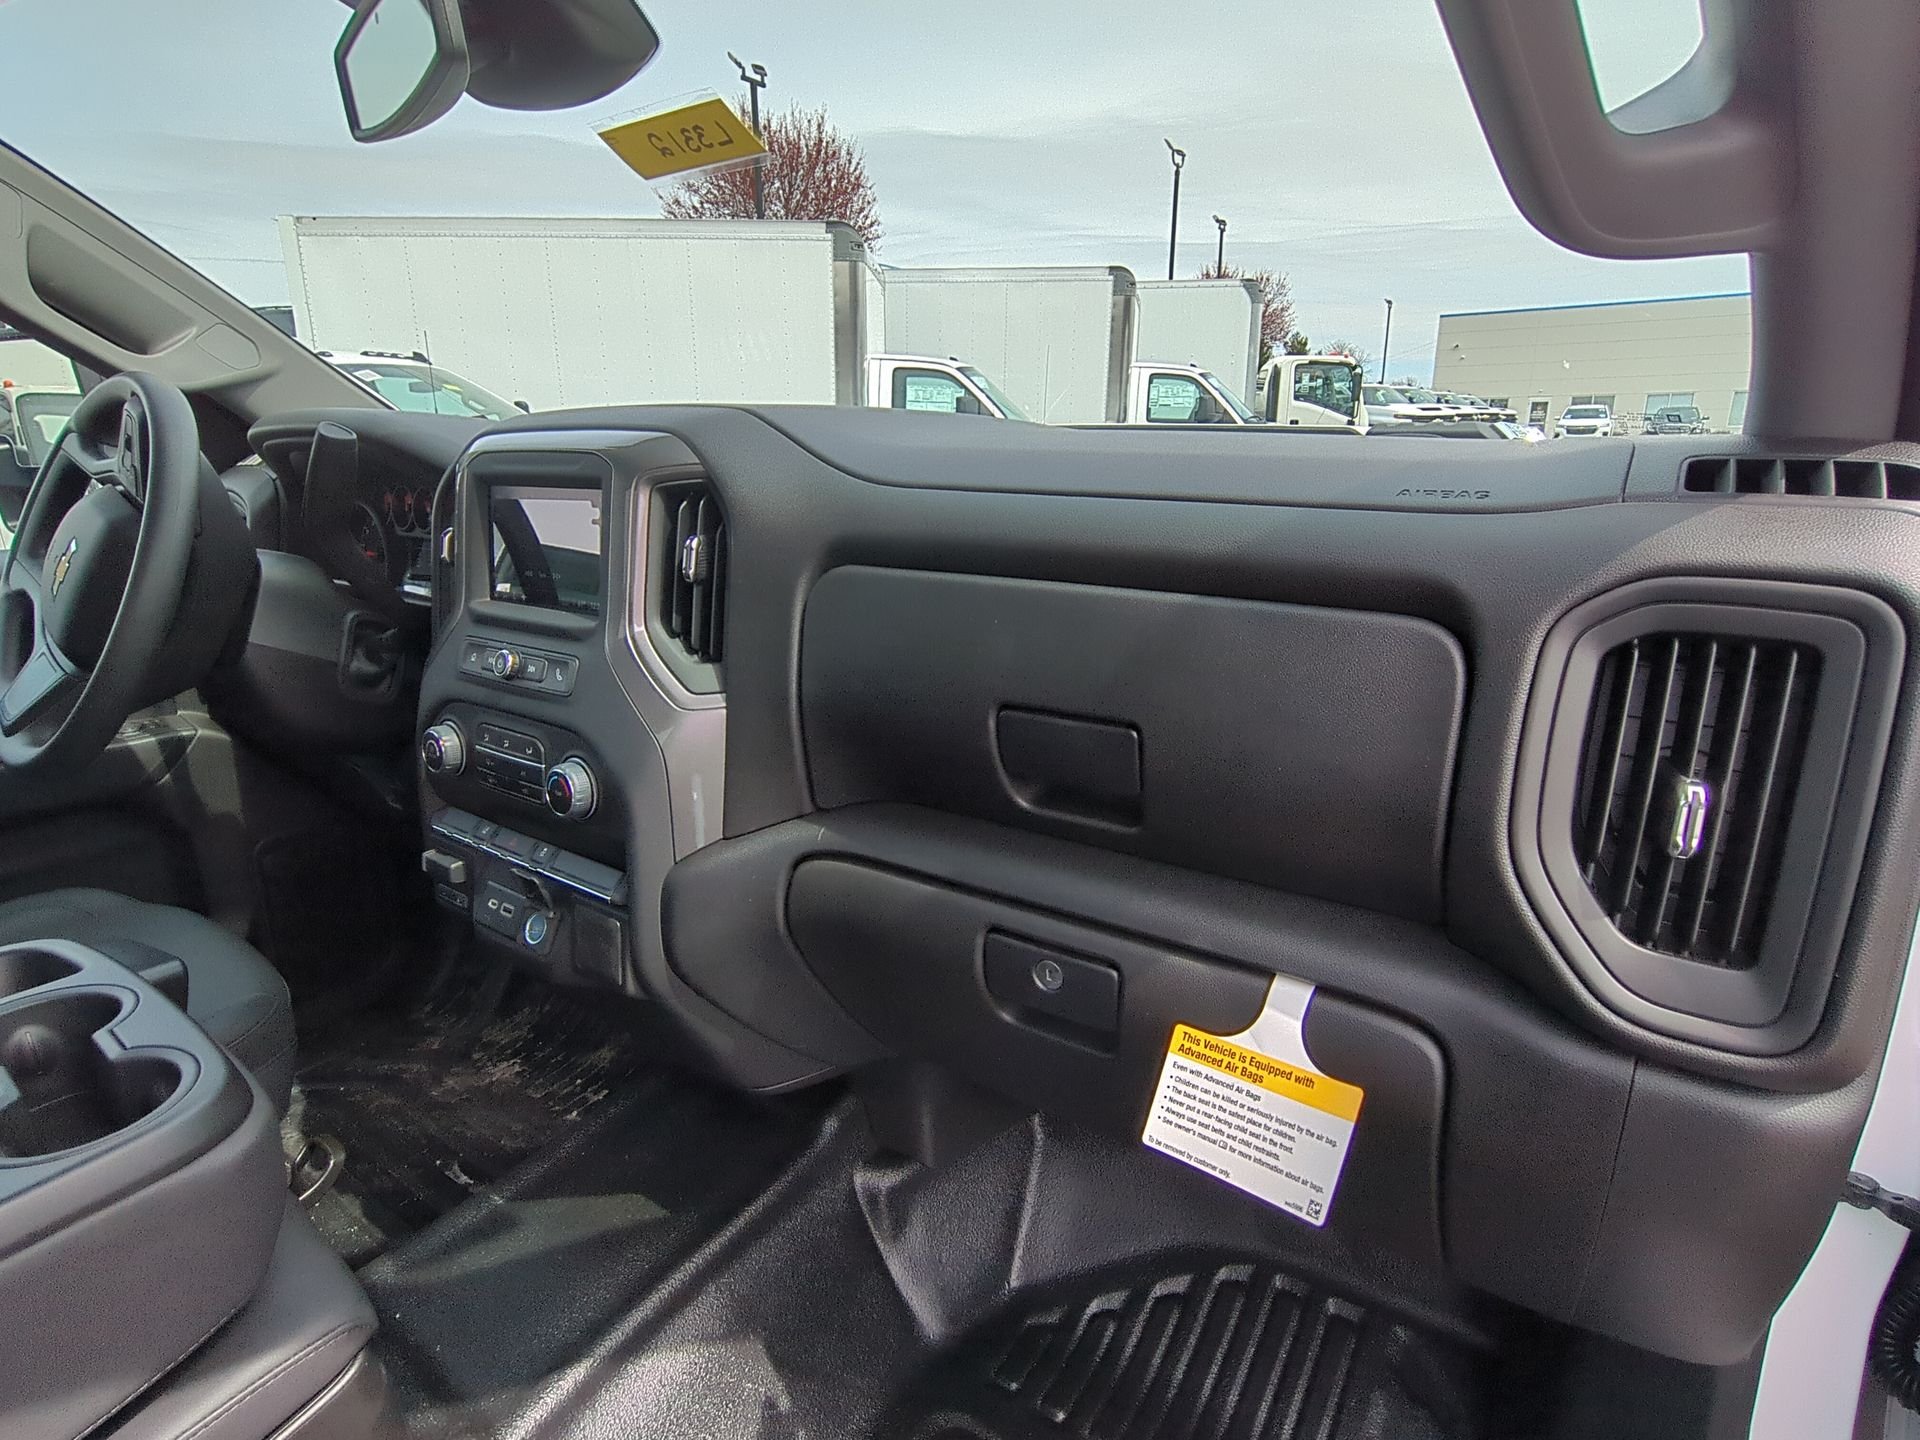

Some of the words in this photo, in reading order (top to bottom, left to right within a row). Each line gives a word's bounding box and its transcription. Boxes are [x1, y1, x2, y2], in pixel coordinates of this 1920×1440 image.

[1395, 488, 1491, 500] AIRBAG
[1172, 1061, 1188, 1072] Even
[1189, 1069, 1203, 1078] with
[1203, 1073, 1234, 1091] Advanced
[1234, 1086, 1245, 1094] Air
[1245, 1089, 1261, 1102] Bags
[1177, 1043, 1224, 1068] Advanced
[1224, 1061, 1239, 1073] Air
[1240, 1066, 1264, 1084] Bags
[1182, 1031, 1201, 1046] This
[1204, 1039, 1236, 1059] Vehicle
[1238, 1052, 1247, 1063] is
[1248, 1056, 1293, 1081] Equipped
[1294, 1075, 1315, 1089] with
[1165, 1106, 1185, 1120] Always
[1186, 1116, 1197, 1124] use
[1197, 1121, 1210, 1130] seat
[1211, 1125, 1225, 1137] belts
[1226, 1133, 1238, 1142] and
[1237, 1138, 1252, 1149] child
[1168, 1096, 1185, 1107] Never
[1185, 1104, 1196, 1112] put
[1201, 1110, 1233, 1129] rear-facing
[1233, 1124, 1248, 1134] child
[1248, 1130, 1261, 1140] seat
[1261, 1135, 1268, 1143] in
[1268, 1138, 1278, 1147] the
[1172, 1085, 1182, 1095] The
[1183, 1090, 1197, 1101] back
[1198, 1097, 1211, 1107] seat
[1217, 1104, 1227, 1113] the
[1228, 1110, 1246, 1122] safest
[1245, 1117, 1262, 1128] place
[1263, 1123, 1272, 1132] for
[1174, 1075, 1199, 1090] Children
[1200, 1087, 1211, 1095] can
[1212, 1090, 1220, 1099] be
[1221, 1094, 1238, 1106] killed
[1246, 1105, 1274, 1122] seriously
[1274, 1116, 1296, 1130] injured
[1296, 1125, 1304, 1134] by
[1305, 1128, 1315, 1138] the
[1148, 1134, 1154, 1143] To
[1155, 1138, 1162, 1146] be
[1162, 1142, 1186, 1157] removed
[1186, 1152, 1193, 1161] by
[1193, 1156, 1218, 1172] customer
[1162, 1116, 1173, 1126] See
[1174, 1122, 1196, 1136] owner's
[1196, 1132, 1218, 1145] manual
[1228, 1145, 1237, 1154] for
[1237, 1150, 1252, 1161] more
[1253, 1156, 1284, 1175] information
[1284, 1171, 1301, 1183] about
